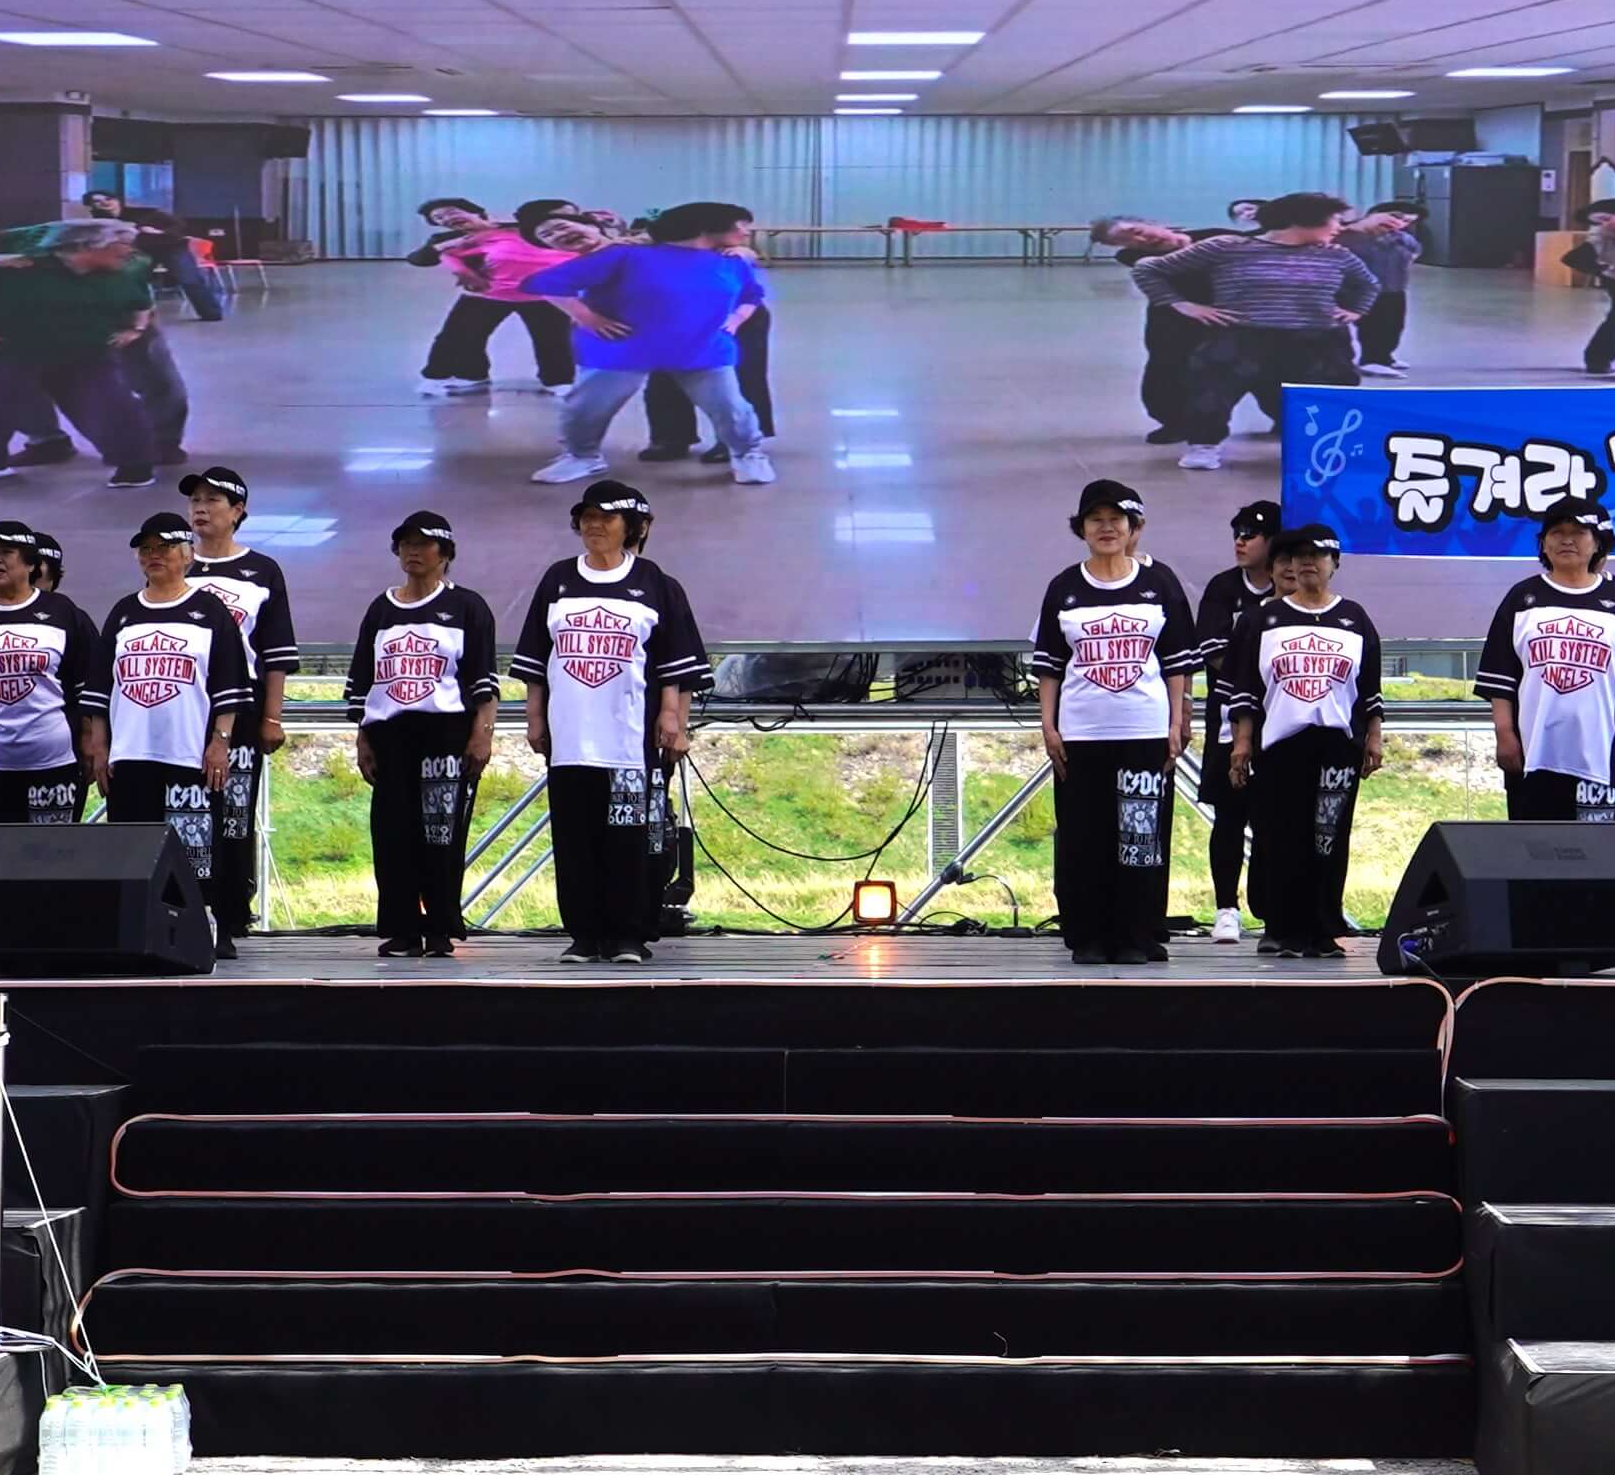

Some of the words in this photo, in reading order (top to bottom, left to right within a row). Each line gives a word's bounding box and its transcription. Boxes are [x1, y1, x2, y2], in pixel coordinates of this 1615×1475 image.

[1388, 436, 1594, 523] 즐겨라
[573, 611, 621, 629] BLACK
[1090, 617, 1139, 635] BLACK
[1546, 620, 1594, 638] BLACK
[131, 635, 178, 651] BLACK
[388, 636, 432, 653] BLACK
[1289, 637, 1334, 652] BLACK
[1530, 640, 1554, 662] KILL
[1560, 641, 1608, 667] SYSTEM
[0, 654, 46, 674] SYSTEM
[145, 657, 193, 680] SYSTEM
[570, 660, 616, 683] ANGELS
[1090, 666, 1139, 688] ANGELS
[129, 682, 173, 703] ANGELS
